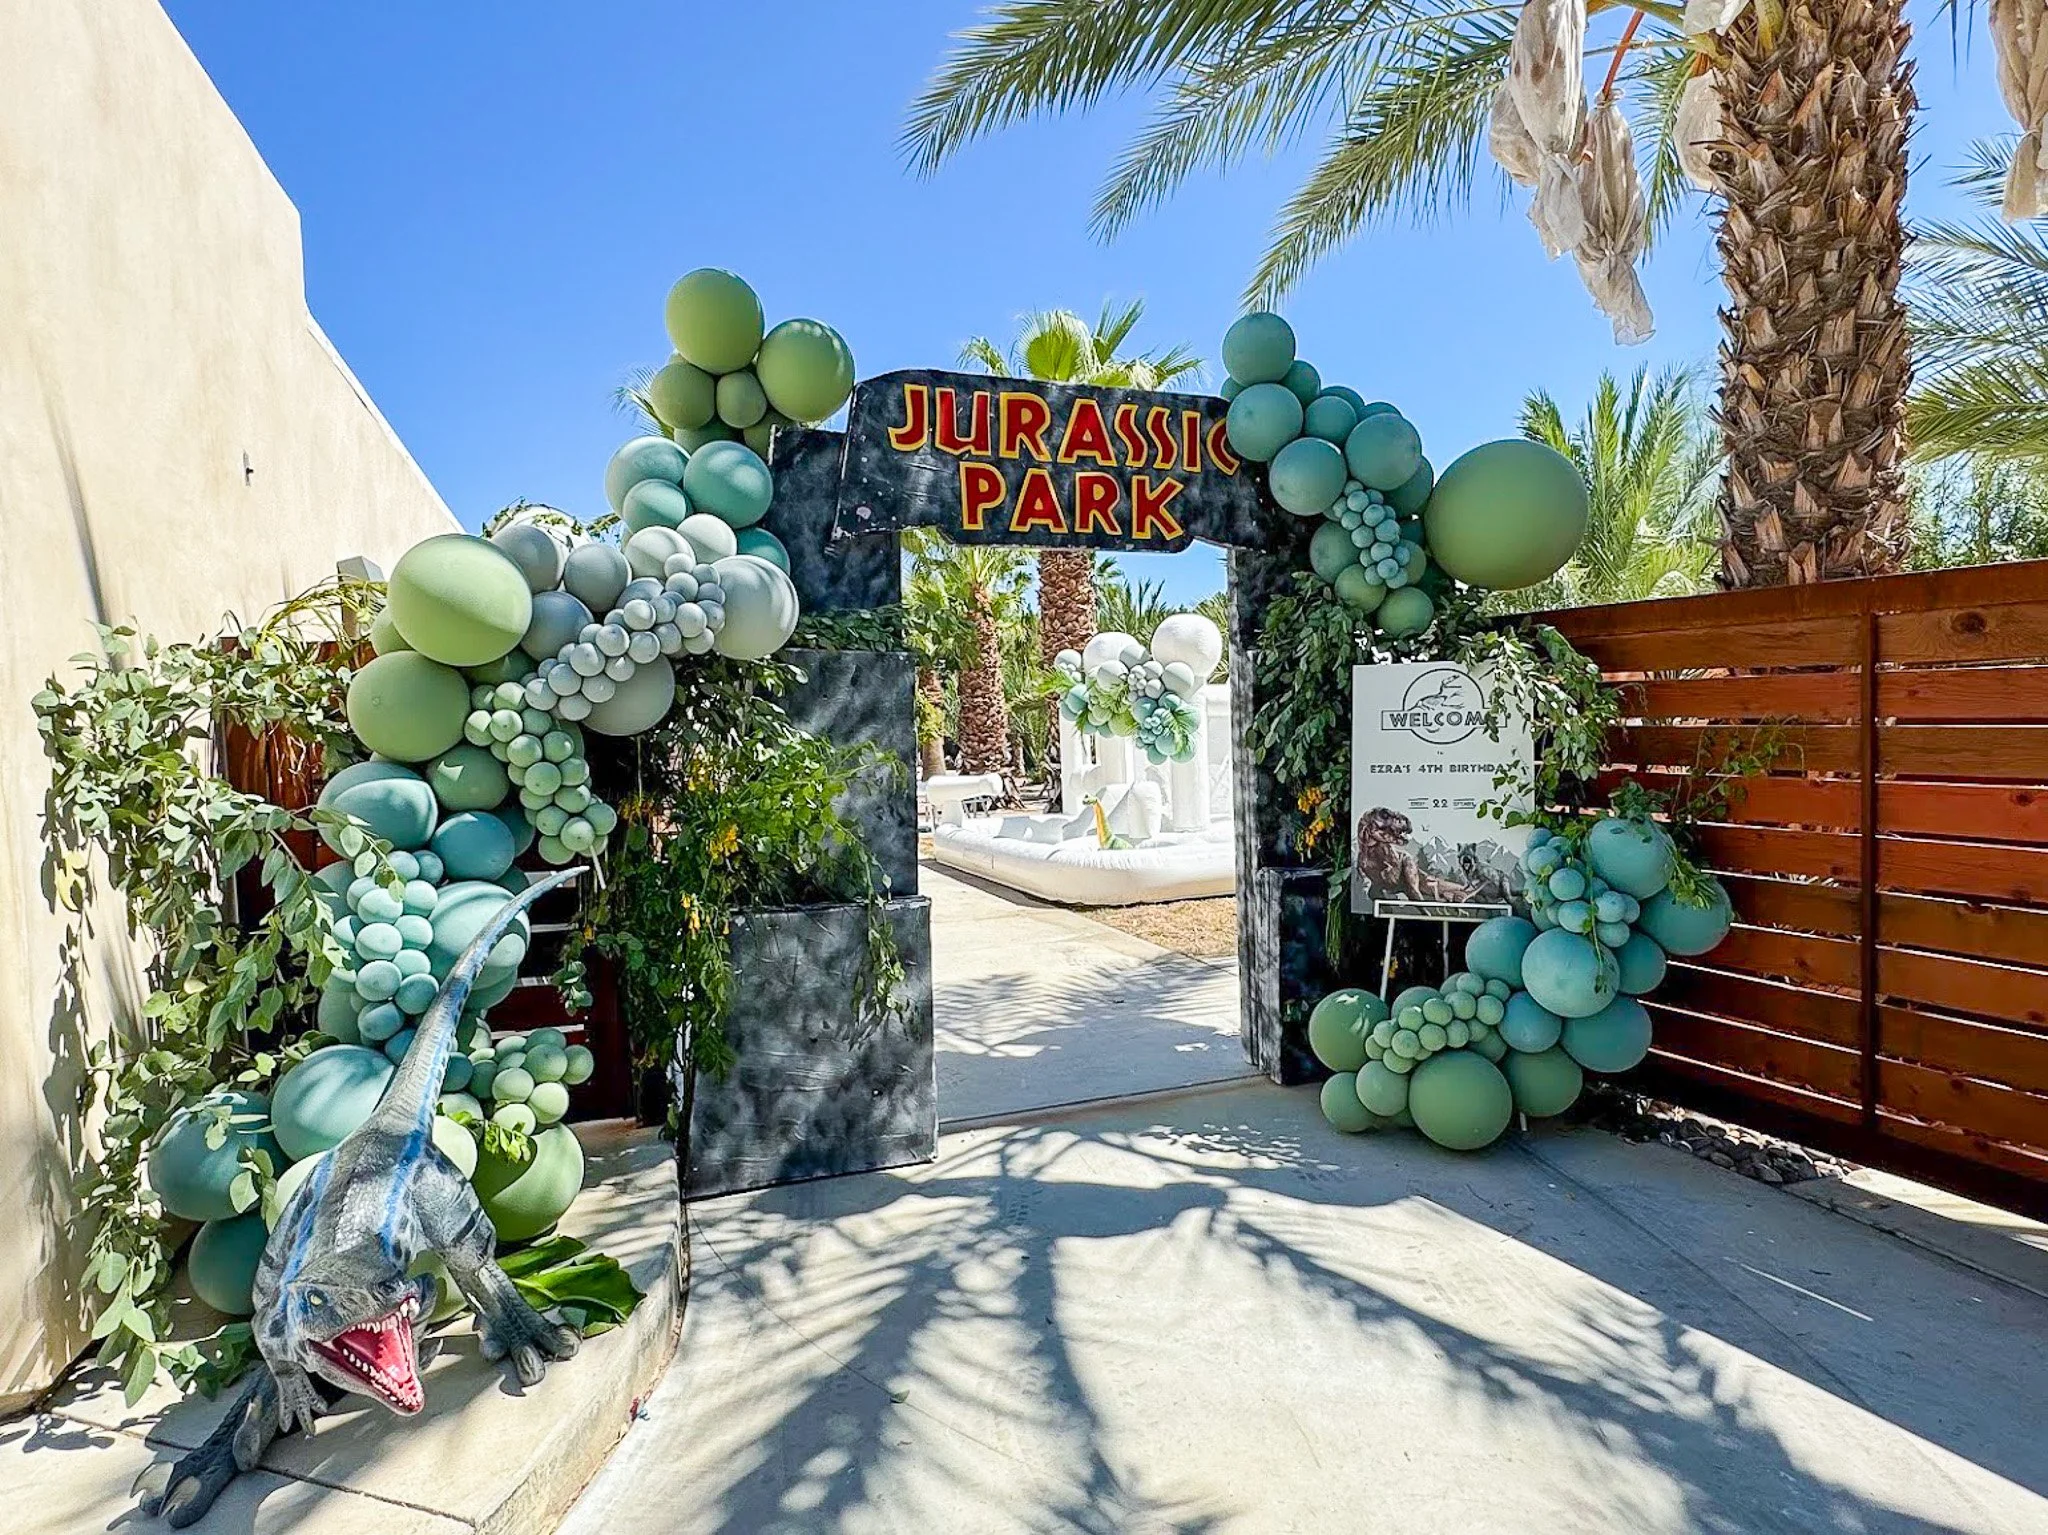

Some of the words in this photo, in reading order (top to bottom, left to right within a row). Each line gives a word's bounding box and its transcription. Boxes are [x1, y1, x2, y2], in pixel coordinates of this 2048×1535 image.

[887, 383, 1240, 475] JURASSIC
[959, 461, 1184, 540] PARK
[1389, 711, 1498, 728] WELCOM
[1370, 764, 1411, 773] EZRA'S
[1418, 764, 1443, 773] 4TH
[1433, 799, 1448, 808] 22
